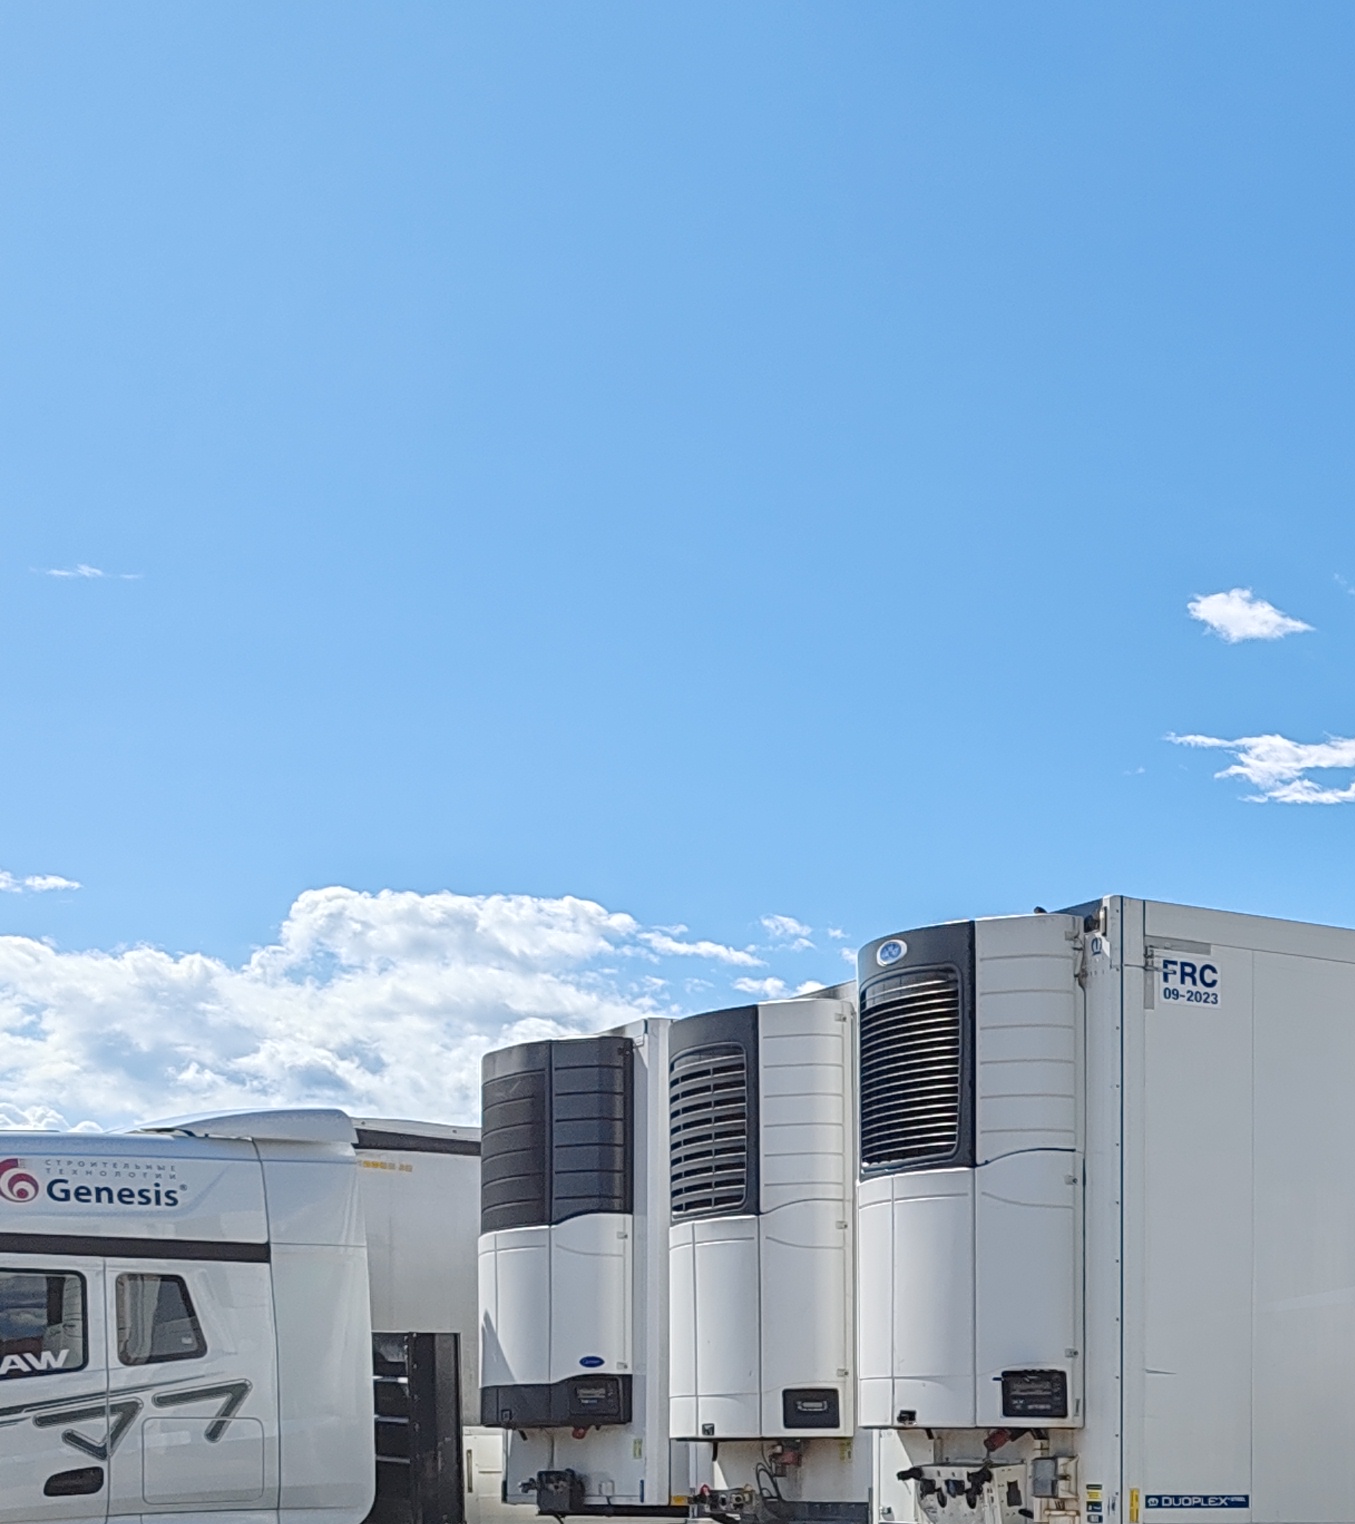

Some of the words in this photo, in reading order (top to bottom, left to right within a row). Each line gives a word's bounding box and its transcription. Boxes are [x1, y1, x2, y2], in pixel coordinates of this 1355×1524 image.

[1163, 959, 1218, 988] FRC
[1163, 987, 1219, 1005] 09-2023
[1161, 1497, 1228, 1506] DUOPLEX
